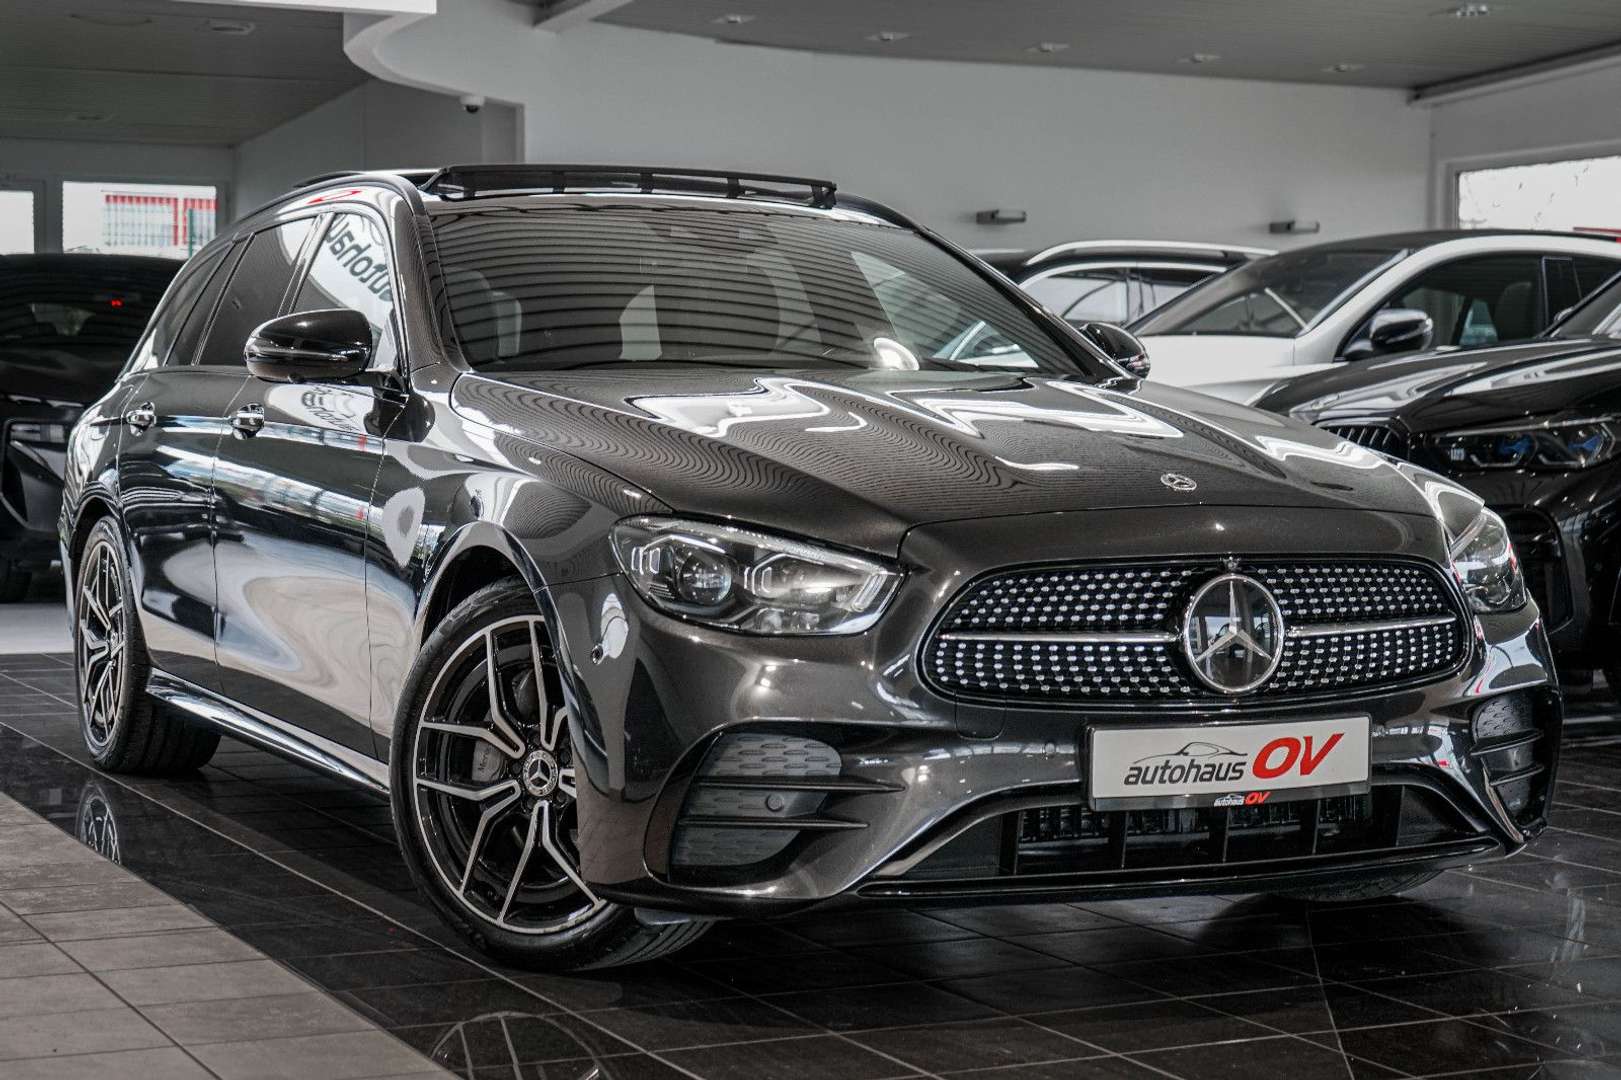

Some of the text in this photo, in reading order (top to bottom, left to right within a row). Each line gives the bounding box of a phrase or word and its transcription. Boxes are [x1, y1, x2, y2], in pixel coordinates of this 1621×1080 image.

[1123, 733, 1345, 786] autohaus OV
[1245, 792, 1271, 805] OV
